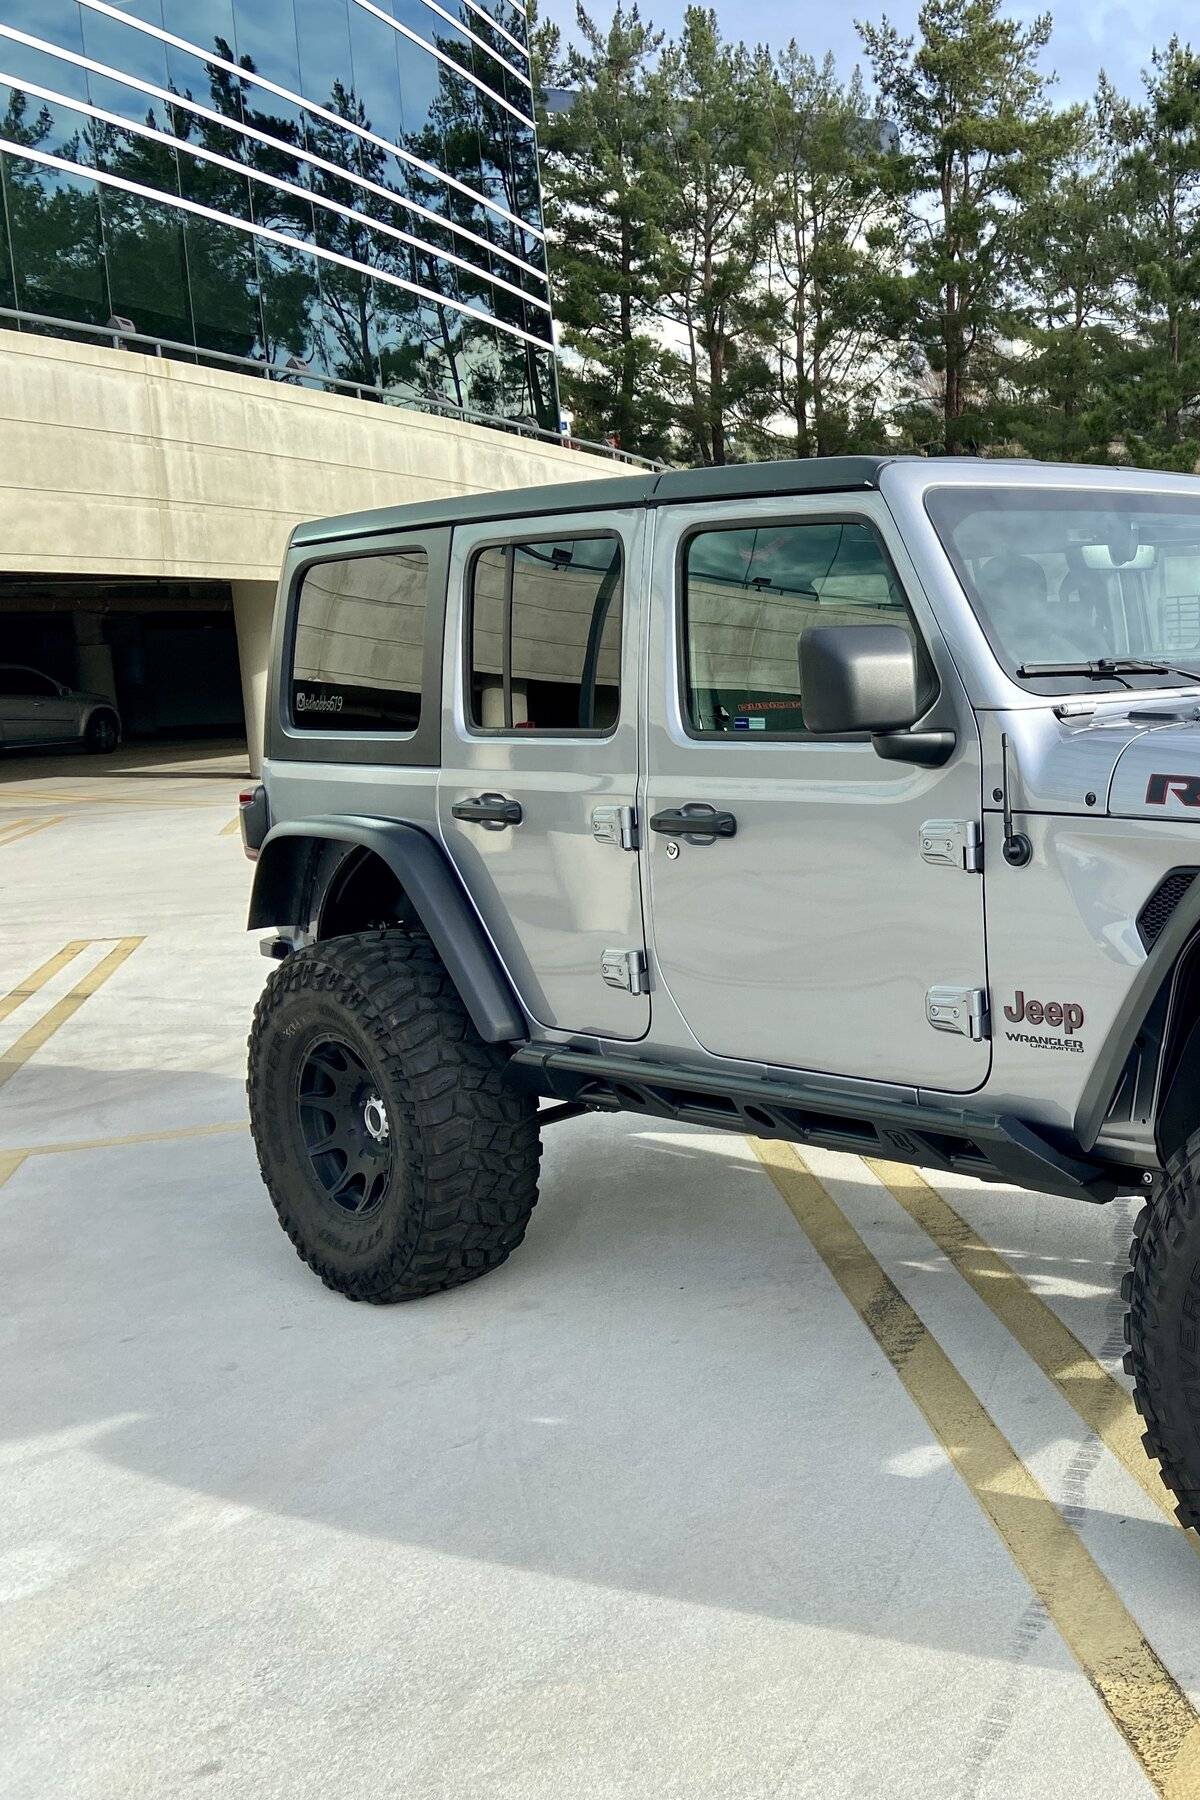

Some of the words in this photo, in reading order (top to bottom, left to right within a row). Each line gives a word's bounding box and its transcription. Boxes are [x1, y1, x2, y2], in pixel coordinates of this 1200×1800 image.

[1003, 990, 1084, 1035] Jeep
[1005, 1031, 1084, 1049] WRANGLER
[1029, 1043, 1085, 1053] UNLIMITED
